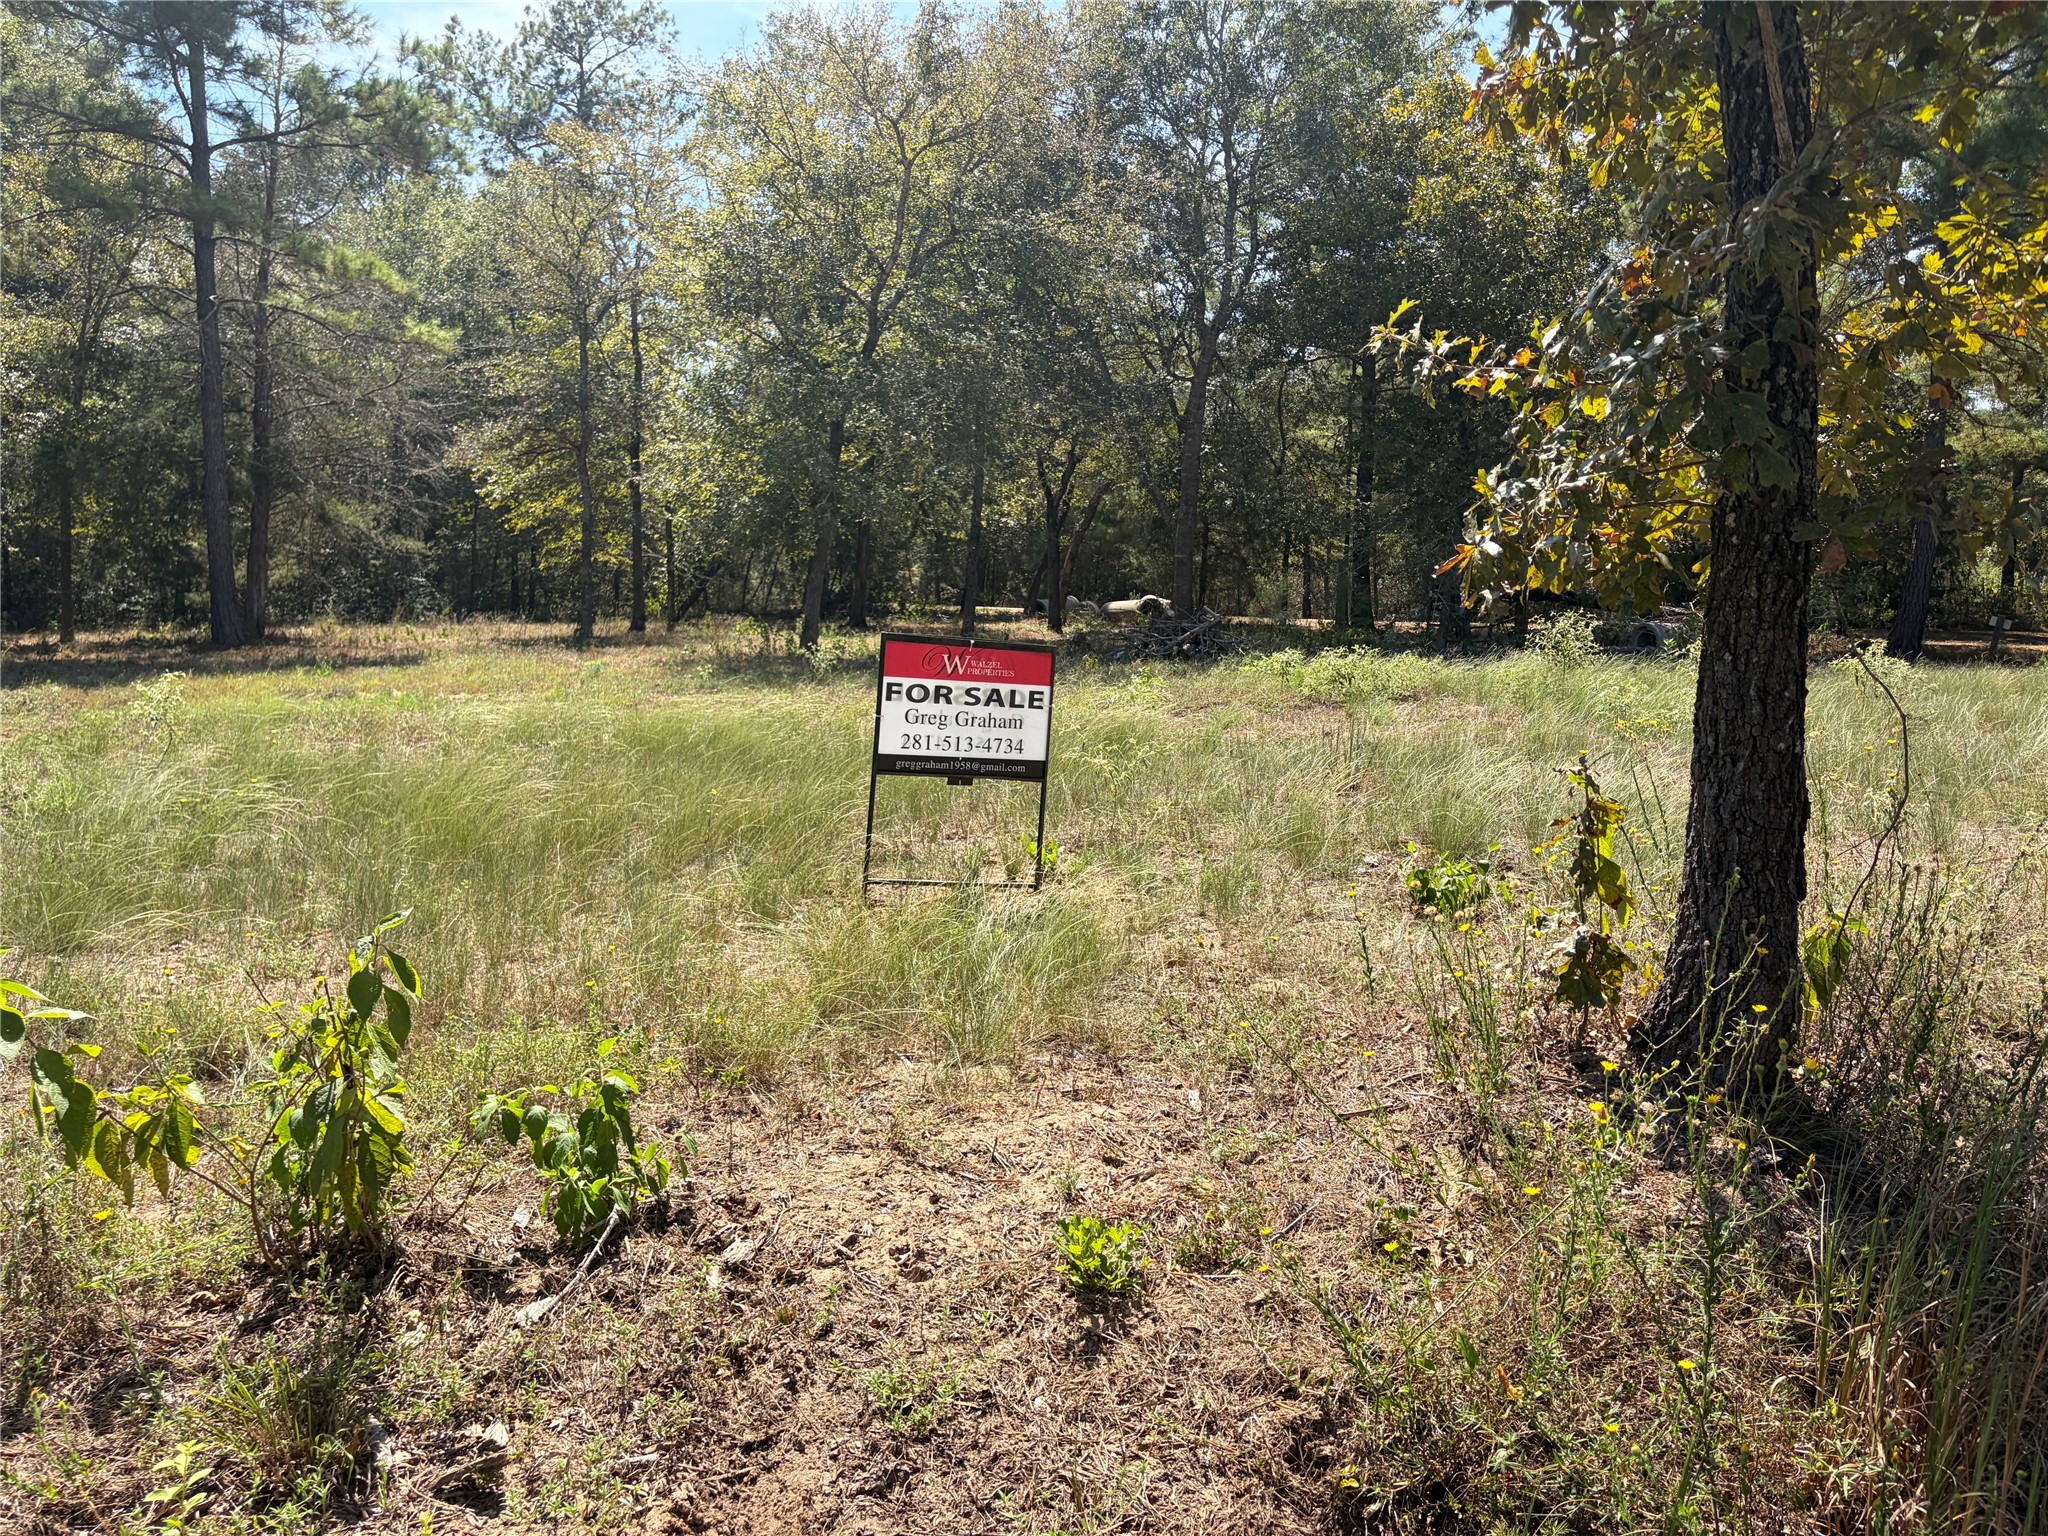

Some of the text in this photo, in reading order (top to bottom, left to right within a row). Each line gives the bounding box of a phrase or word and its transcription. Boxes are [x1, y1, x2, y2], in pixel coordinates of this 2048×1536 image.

[967, 668, 1015, 677] PROPERTIES
[971, 660, 1003, 669] WALZEL
[885, 682, 1044, 710] FOR SALE
[904, 708, 1023, 730] Greg Graham
[900, 733, 1024, 754] 281-513-4734
[895, 759, 1026, 773] greggraham1958@gmail.com
